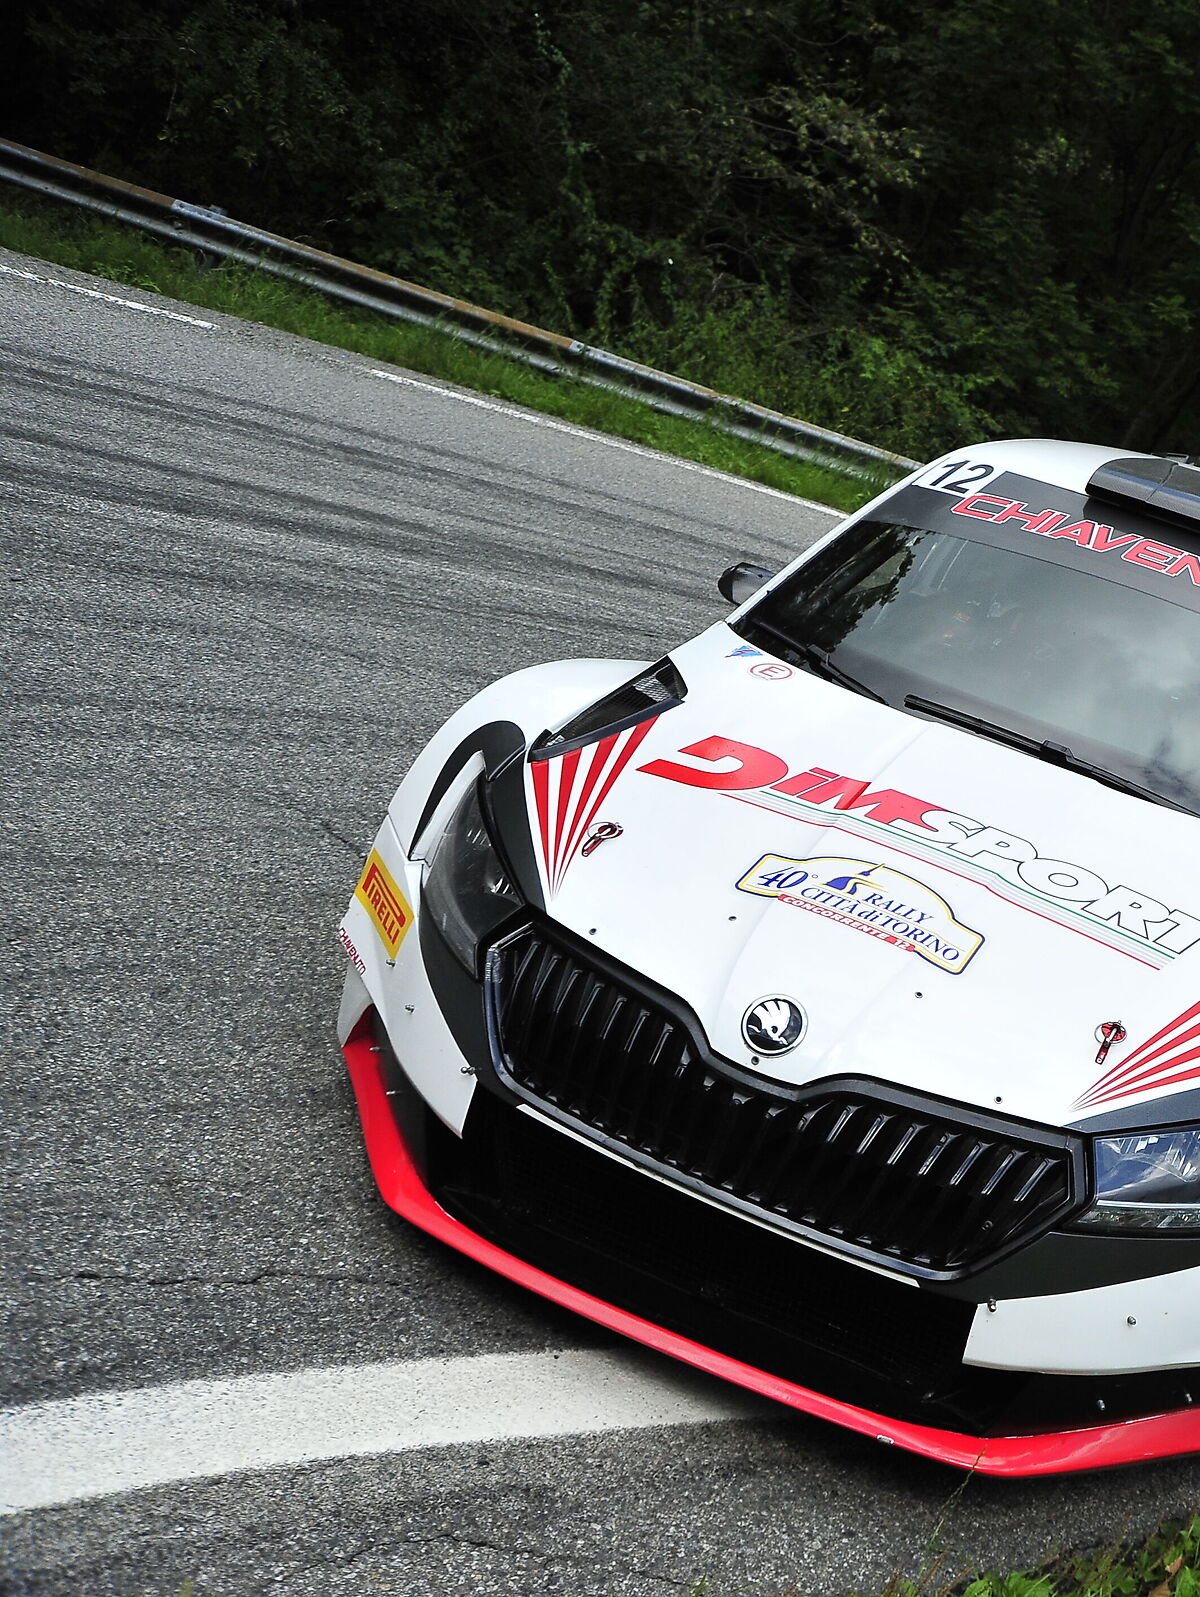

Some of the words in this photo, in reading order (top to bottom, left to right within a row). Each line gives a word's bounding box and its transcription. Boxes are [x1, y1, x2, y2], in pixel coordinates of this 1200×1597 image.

[929, 460, 995, 495] 12
[362, 861, 407, 945] PIRELLI
[781, 896, 891, 941] CONCORRENTE
[893, 938, 911, 951] 12
[862, 892, 934, 925] RALLY
[878, 917, 961, 962] TORINO
